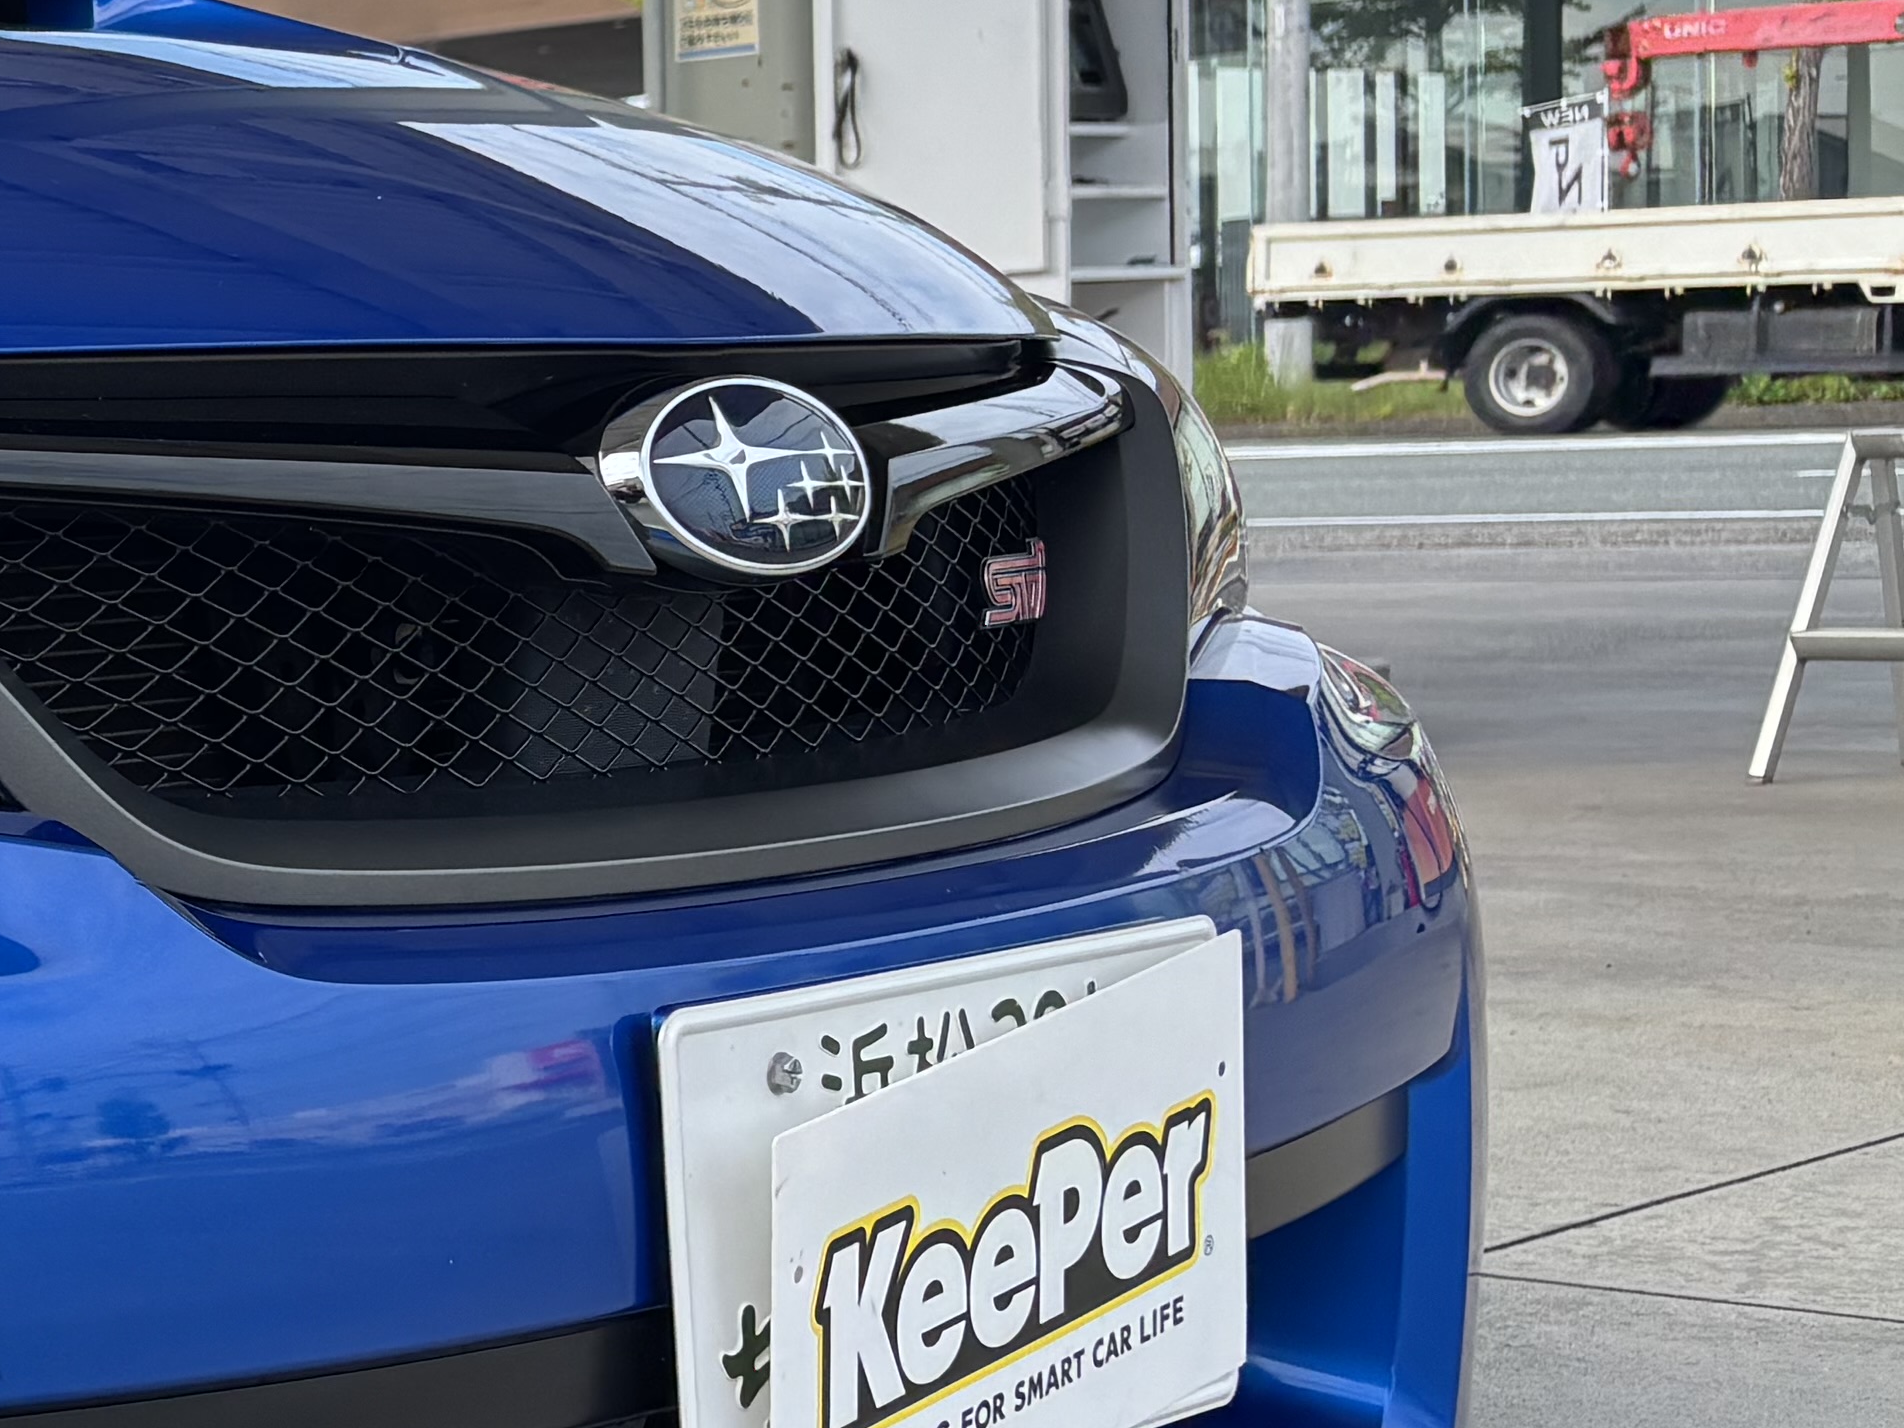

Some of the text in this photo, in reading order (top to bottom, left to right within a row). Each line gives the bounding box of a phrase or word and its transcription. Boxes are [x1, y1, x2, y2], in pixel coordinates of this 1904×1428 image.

[1013, 1350, 1085, 1412] SMART
[1091, 1326, 1134, 1371] CAR
[1139, 1295, 1185, 1345] LIFE
